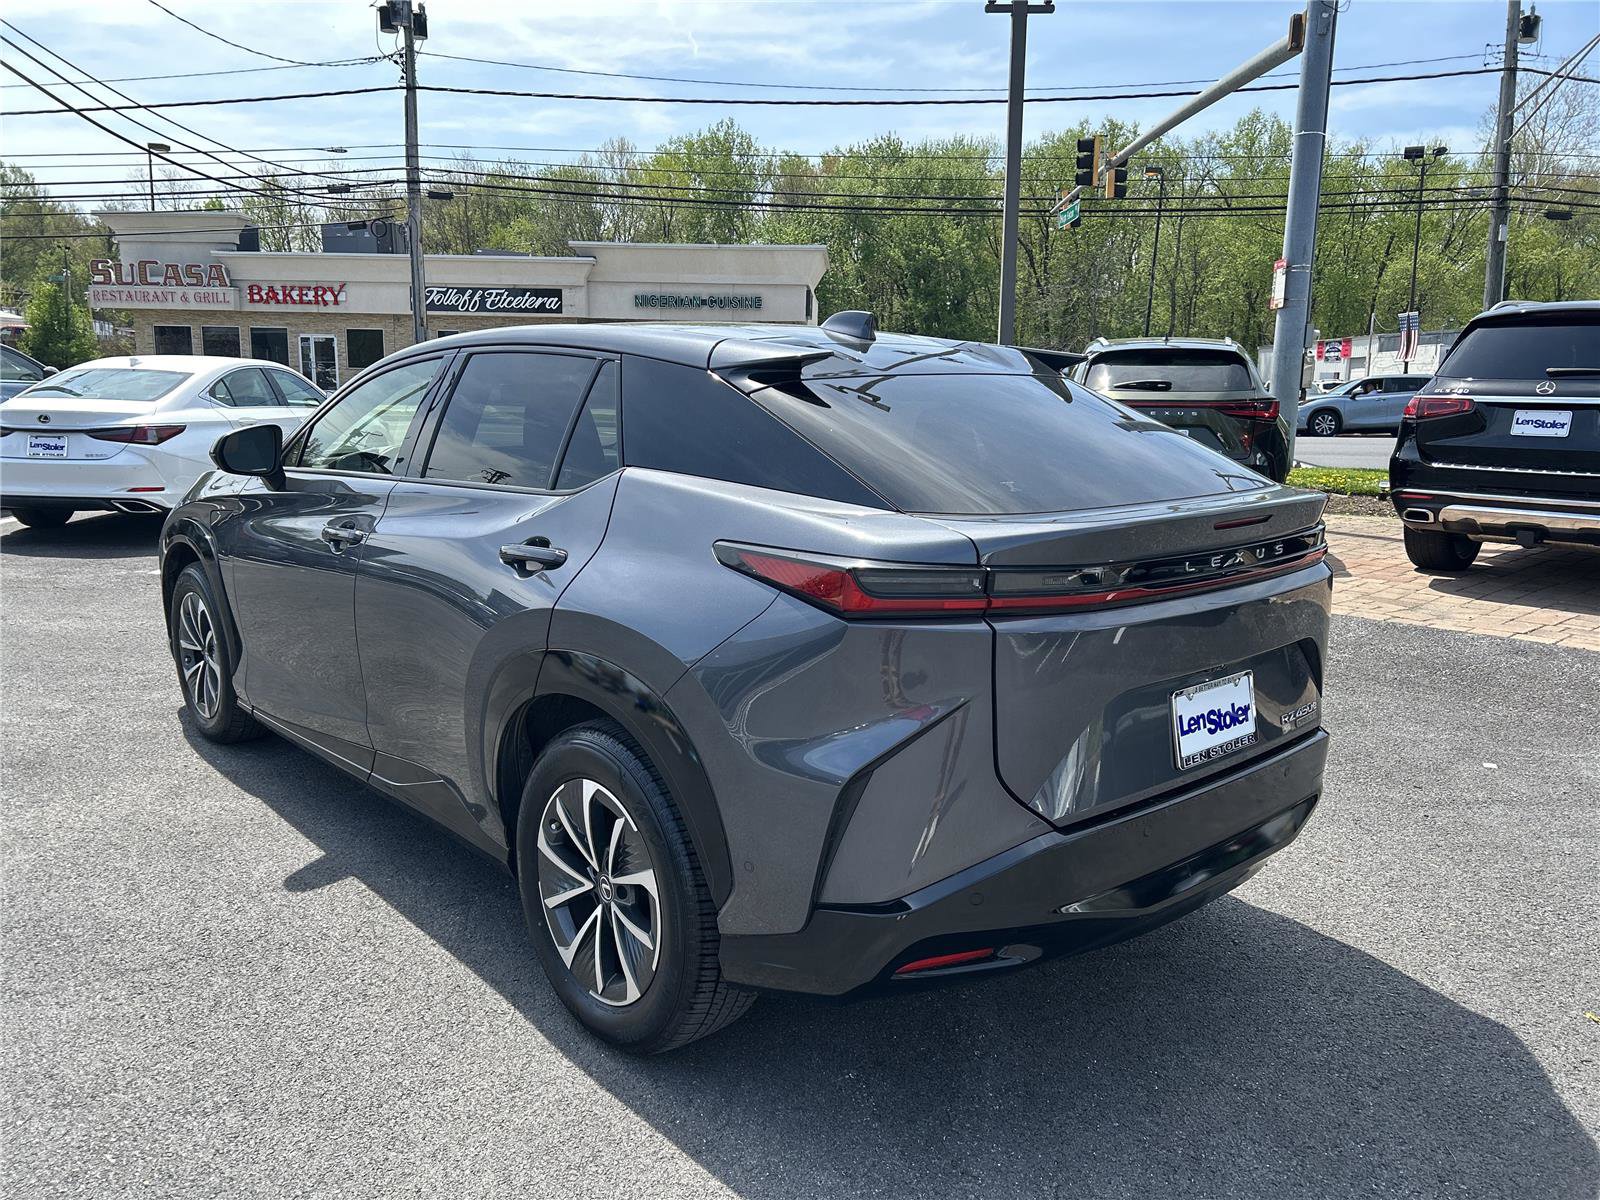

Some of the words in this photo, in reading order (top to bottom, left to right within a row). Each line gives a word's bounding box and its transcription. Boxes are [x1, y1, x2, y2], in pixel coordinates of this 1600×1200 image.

[92, 289, 176, 303] RESTAURANT
[180, 292, 189, 304] &
[193, 291, 230, 304] GRILL
[247, 281, 346, 307] BAKERY
[484, 288, 561, 310] Etcetera
[634, 294, 701, 309] NIGERIAN
[706, 295, 763, 309] CUISINE
[1185, 543, 1284, 572] LEXUS
[1184, 752, 1208, 767] LEN
[1209, 734, 1256, 758] STOLER
